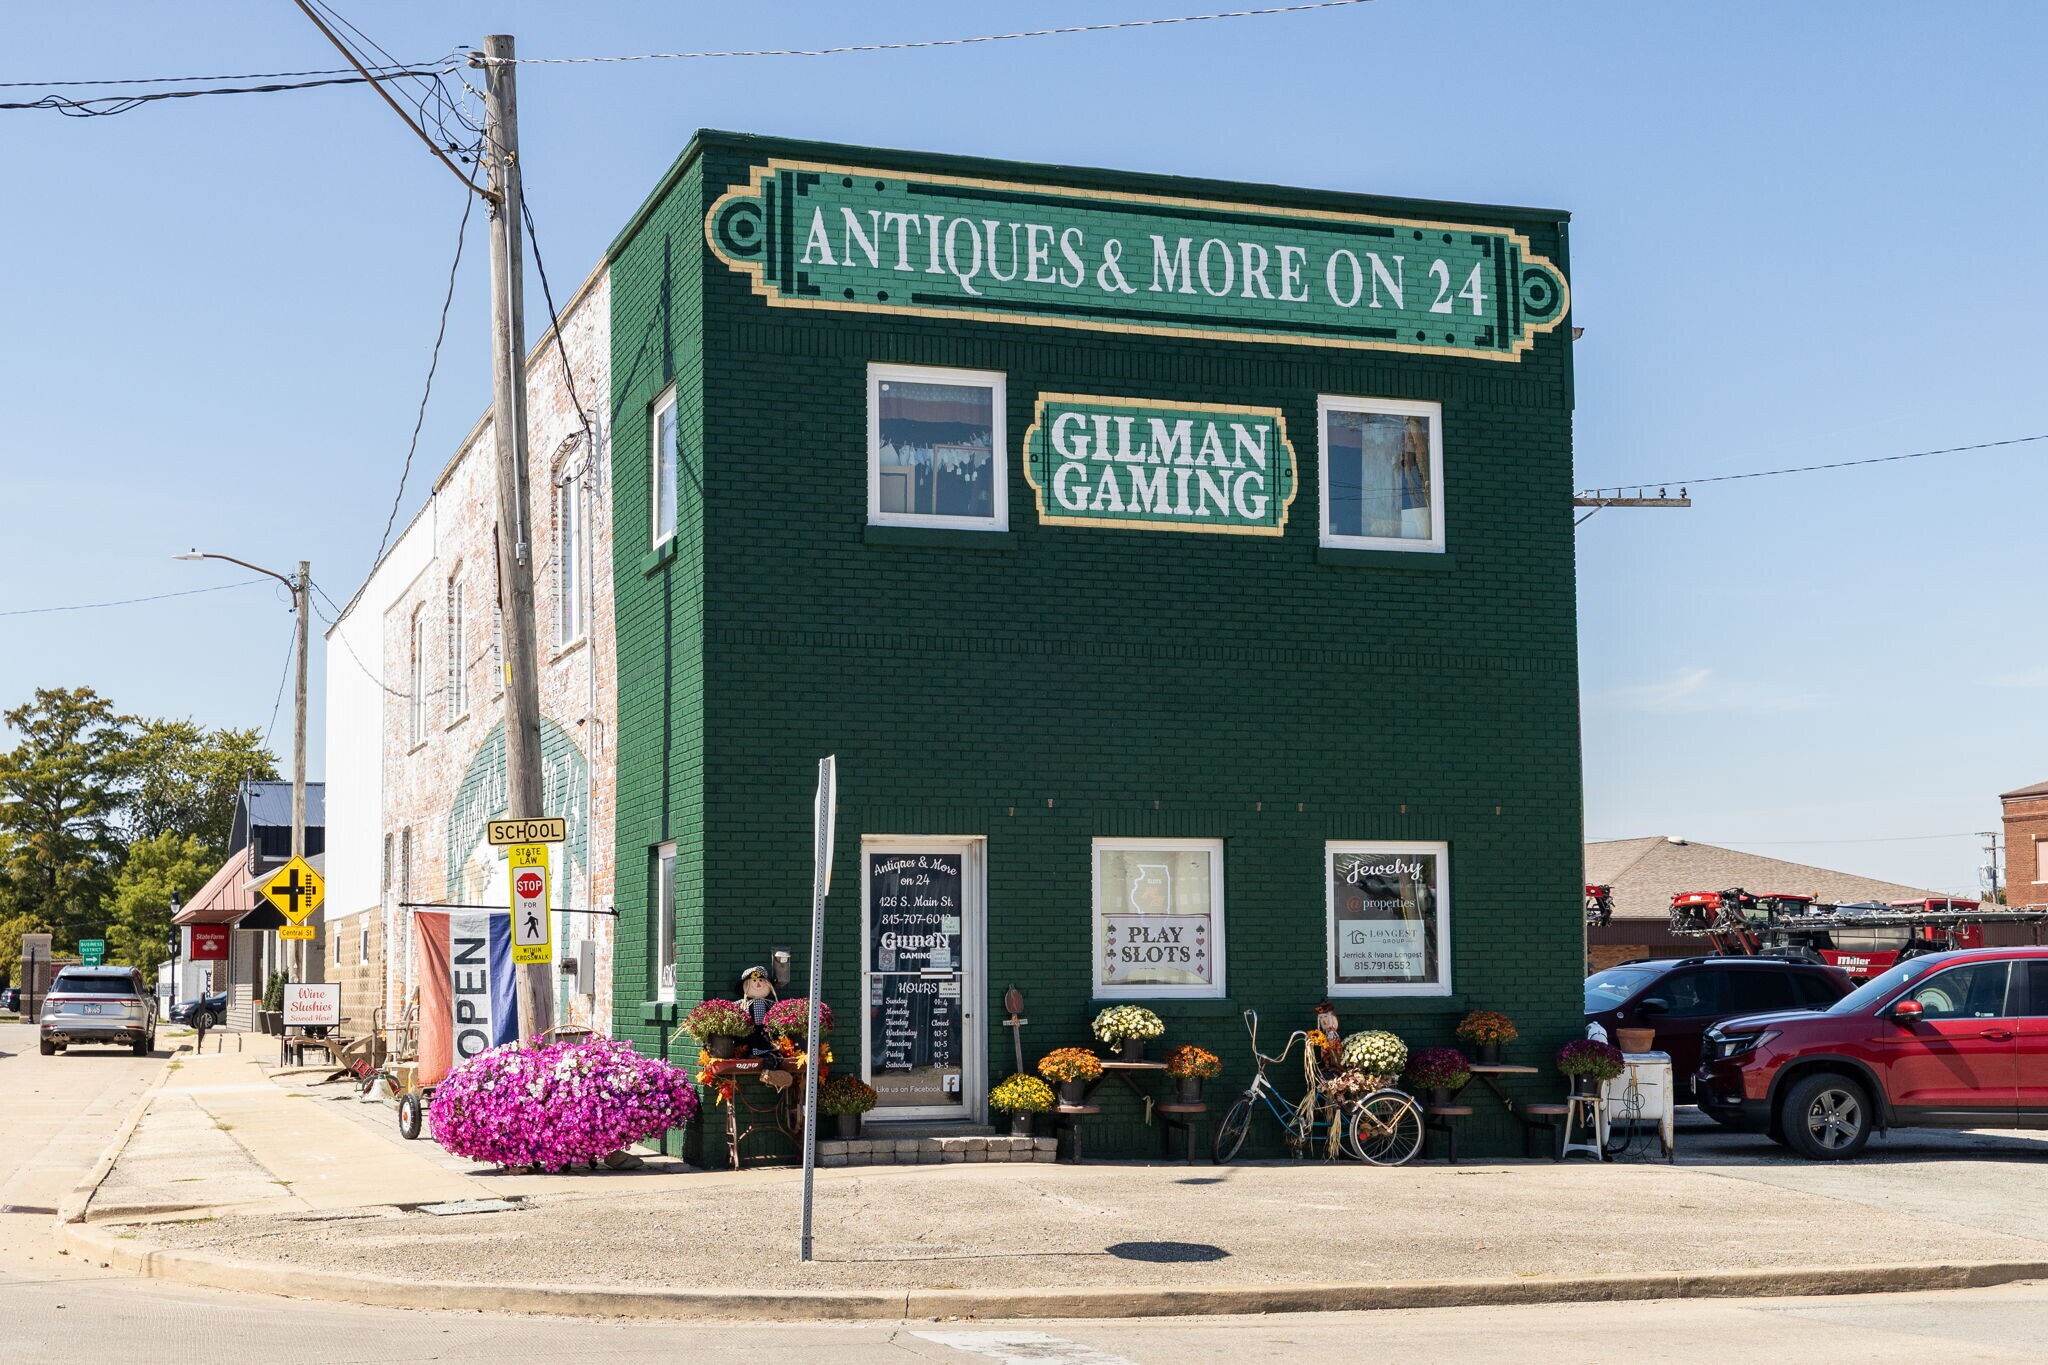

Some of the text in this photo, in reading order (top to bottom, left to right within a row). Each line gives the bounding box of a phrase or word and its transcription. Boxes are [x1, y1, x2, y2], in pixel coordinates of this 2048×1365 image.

[800, 205, 1489, 317] ANTIQUES & MORE ON 24
[1050, 411, 1270, 471] GILMAN
[1052, 461, 1270, 520] GAMING
[494, 823, 561, 840] SCHOOL
[515, 847, 542, 856] STATE
[519, 857, 538, 865] LAW
[874, 855, 958, 876] Antiques & More
[1346, 858, 1424, 884] Jewelry
[900, 874, 931, 886] on 24
[516, 880, 543, 892] STOP
[879, 894, 954, 907] 126 S. Main St.
[281, 928, 313, 936] Central St
[1127, 926, 1184, 944] PLAY
[1369, 929, 1418, 940] LONGEST
[516, 953, 549, 962] CROSSWALK
[900, 952, 932, 960] GAMING
[1121, 946, 1191, 963] SLOTS
[1342, 951, 1423, 960] Jerrick & Ivana Longest
[1353, 961, 1411, 971] 815.791.6552
[1837, 956, 1871, 965] Miller
[297, 987, 326, 999] Wine
[898, 982, 938, 995] HOURS
[453, 937, 490, 1059] OPEN
[885, 997, 908, 1007] Sunday
[290, 1001, 333, 1012] Slushies
[885, 1008, 910, 1018] Monday
[885, 1018, 950, 1028] Tuesday Closed
[885, 1029, 918, 1039] Wednesday
[885, 1040, 948, 1049] Thursday 10-5
[885, 1050, 905, 1061] Friday
[885, 1061, 913, 1071] Saturday
[876, 1085, 889, 1093] Like
[909, 1085, 941, 1093] Facebook
